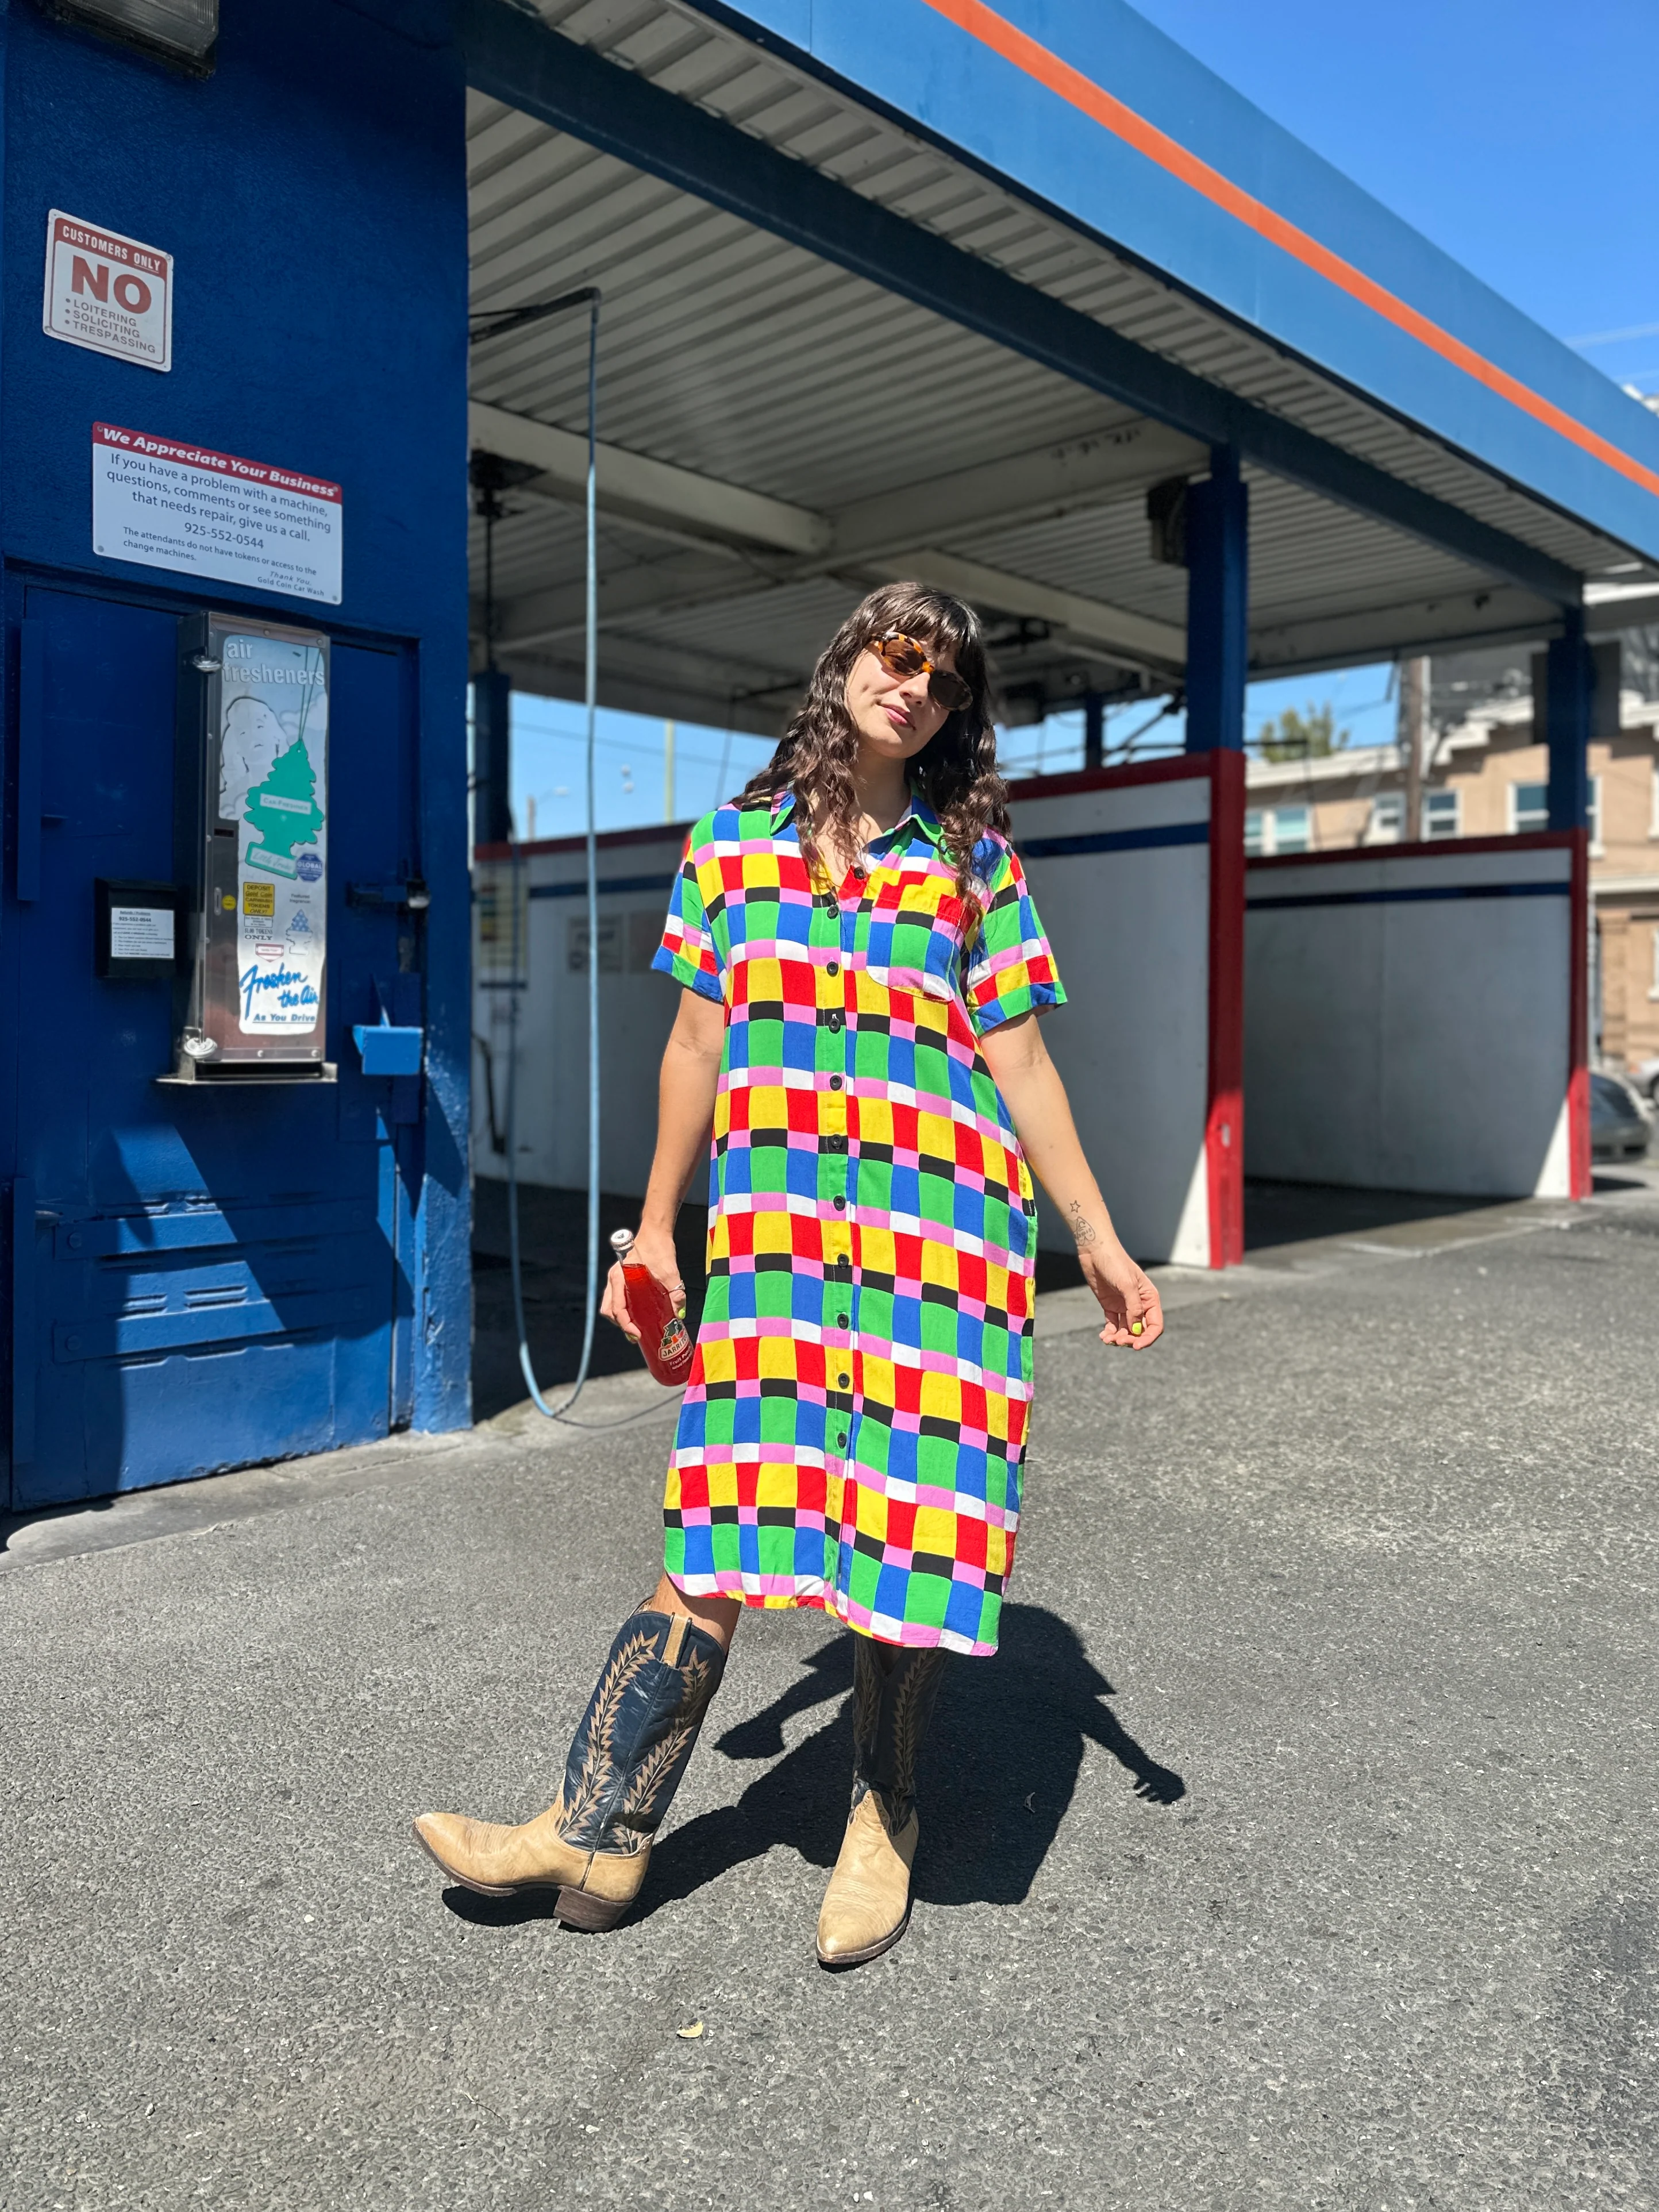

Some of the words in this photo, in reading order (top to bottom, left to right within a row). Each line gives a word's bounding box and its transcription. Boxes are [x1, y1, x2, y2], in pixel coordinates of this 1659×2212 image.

[63, 225, 128, 260] CUSTOMERS
[134, 252, 160, 272] ONLY
[71, 255, 152, 314] NO
[73, 310, 140, 338] SOLICITING
[74, 299, 137, 327] LOITERING
[72, 321, 156, 354] TRESPASSING
[103, 428, 130, 444] We
[133, 437, 227, 469] Appreciate
[230, 460, 267, 479] Your
[269, 471, 335, 497] Business
[111, 453, 120, 465] If
[122, 458, 145, 471] you
[149, 462, 178, 479] have
[181, 473, 187, 481] a
[191, 475, 240, 494] problem
[243, 487, 268, 501] with
[270, 495, 277, 503] a
[280, 497, 328, 517] machine,
[107, 471, 171, 495] questions,
[174, 487, 235, 508] comments
[238, 502, 251, 511] or
[253, 504, 272, 517] see
[274, 510, 331, 534] something
[132, 491, 158, 506] that
[160, 499, 197, 515] needs
[199, 508, 236, 526] repair,
[239, 517, 263, 530] give
[265, 523, 278, 534] us
[280, 527, 286, 536] a
[289, 529, 310, 542] call.
[184, 522, 264, 549] 925-552-0544
[123, 539, 154, 553] change
[156, 546, 197, 561] machines.
[123, 526, 139, 537] The
[140, 531, 185, 547] attendants
[187, 540, 198, 549] do
[199, 544, 213, 553] not
[214, 546, 233, 557] have
[234, 551, 260, 563] tokens
[271, 560, 294, 571] access
[295, 565, 303, 573] to
[305, 567, 317, 576] the
[257, 576, 274, 585] Gold
[276, 580, 292, 589] Coin
[294, 584, 305, 592] Car
[307, 587, 325, 596] Wash
[270, 571, 294, 583] Thank
[226, 638, 253, 659] air
[222, 662, 325, 685] fresheners
[297, 861, 322, 869] GLOBAL
[238, 962, 309, 1021] Freshen
[277, 989, 299, 1009] the
[253, 1013, 266, 1022] As
[270, 1013, 287, 1022] You
[291, 1013, 315, 1022] Drive
